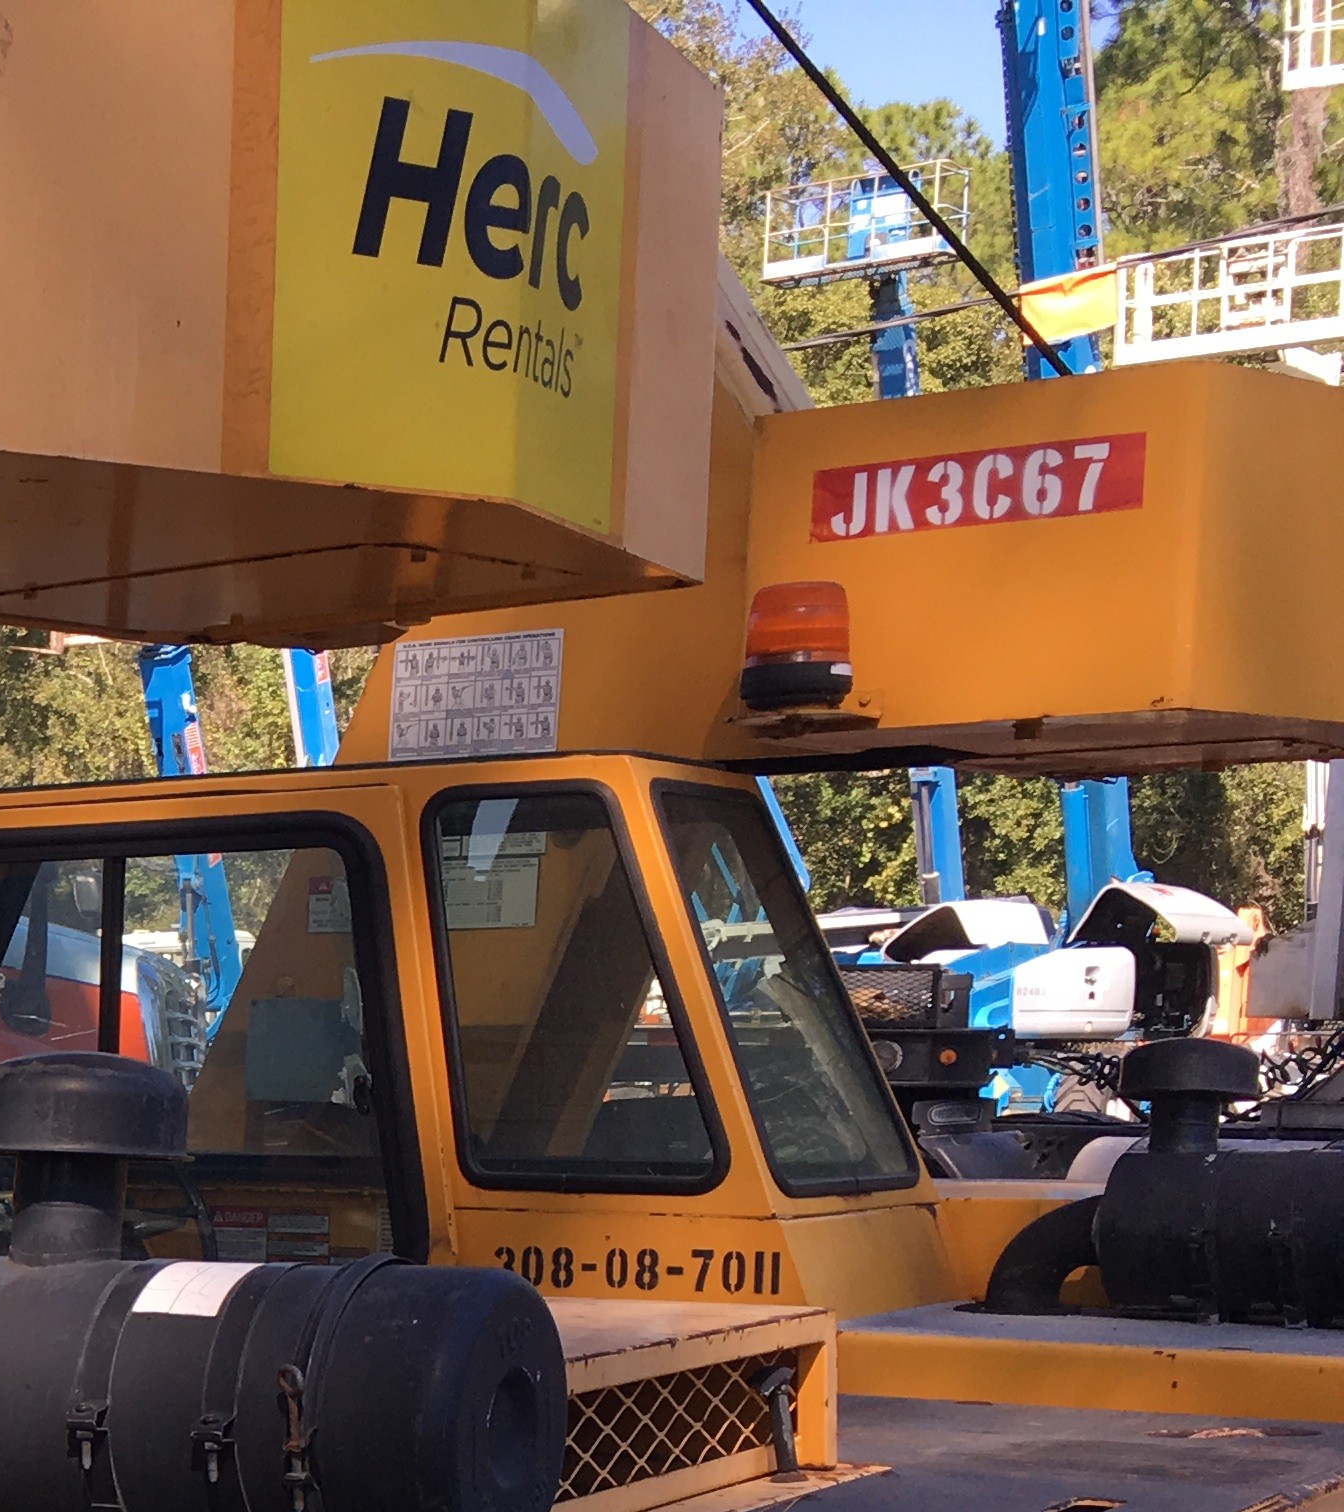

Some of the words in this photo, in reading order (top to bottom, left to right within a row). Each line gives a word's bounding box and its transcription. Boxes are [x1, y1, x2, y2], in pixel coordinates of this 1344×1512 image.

[352, 95, 590, 311] Herc
[438, 295, 575, 398] Rentals
[830, 441, 1111, 537] JK3C67
